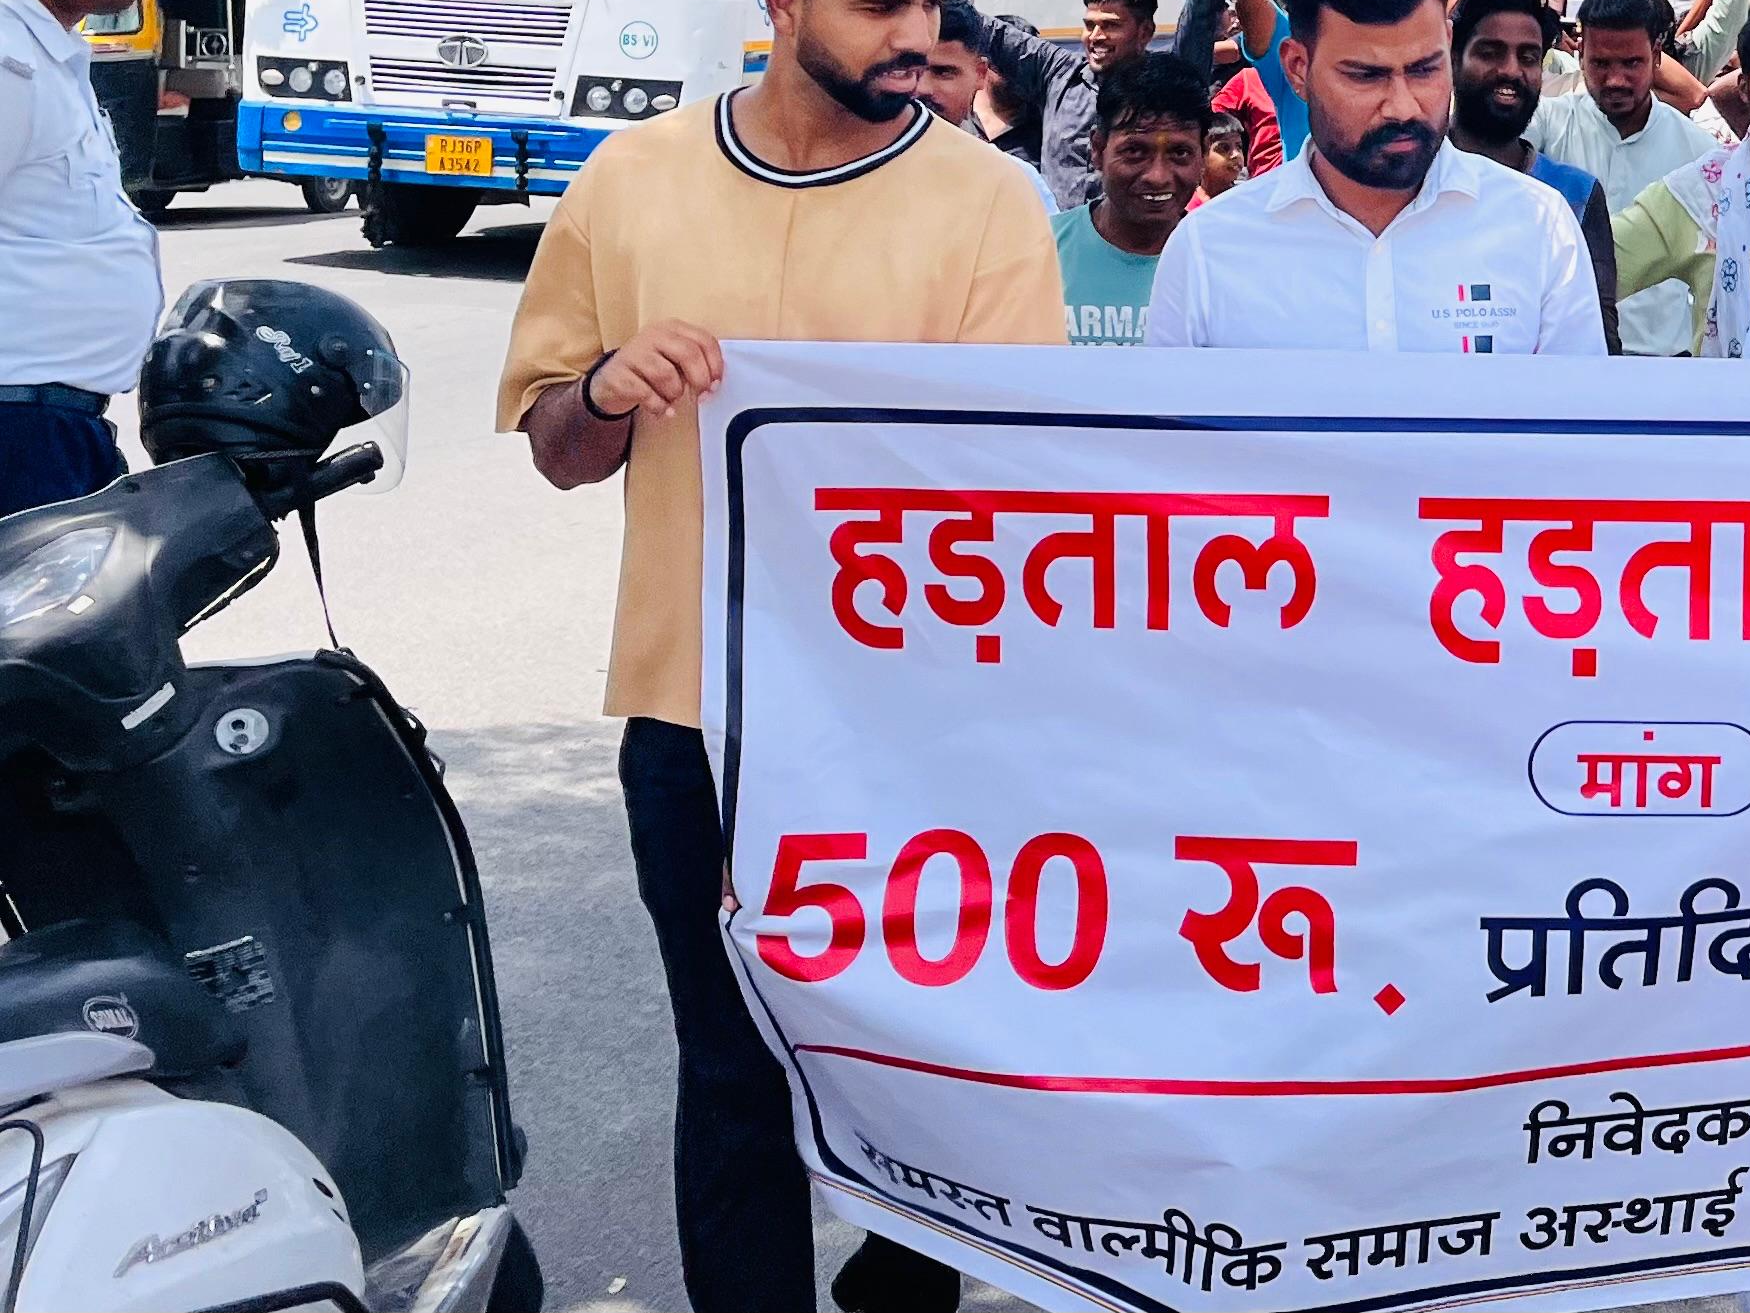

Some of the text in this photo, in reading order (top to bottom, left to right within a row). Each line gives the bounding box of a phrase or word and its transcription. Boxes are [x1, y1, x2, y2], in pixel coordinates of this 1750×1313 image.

[623, 34, 654, 47] BS VI
[440, 157, 480, 173] A3542
[1456, 308, 1487, 318] POLO
[814, 487, 1330, 663] हड़ताल
[1577, 730, 1721, 808] मांग
[756, 828, 1108, 991] 500
[1025, 1207, 1288, 1293] वाल्मीकि
[1304, 1211, 1501, 1280] समाज
[1519, 1166, 1750, 1251] अस्थाई
